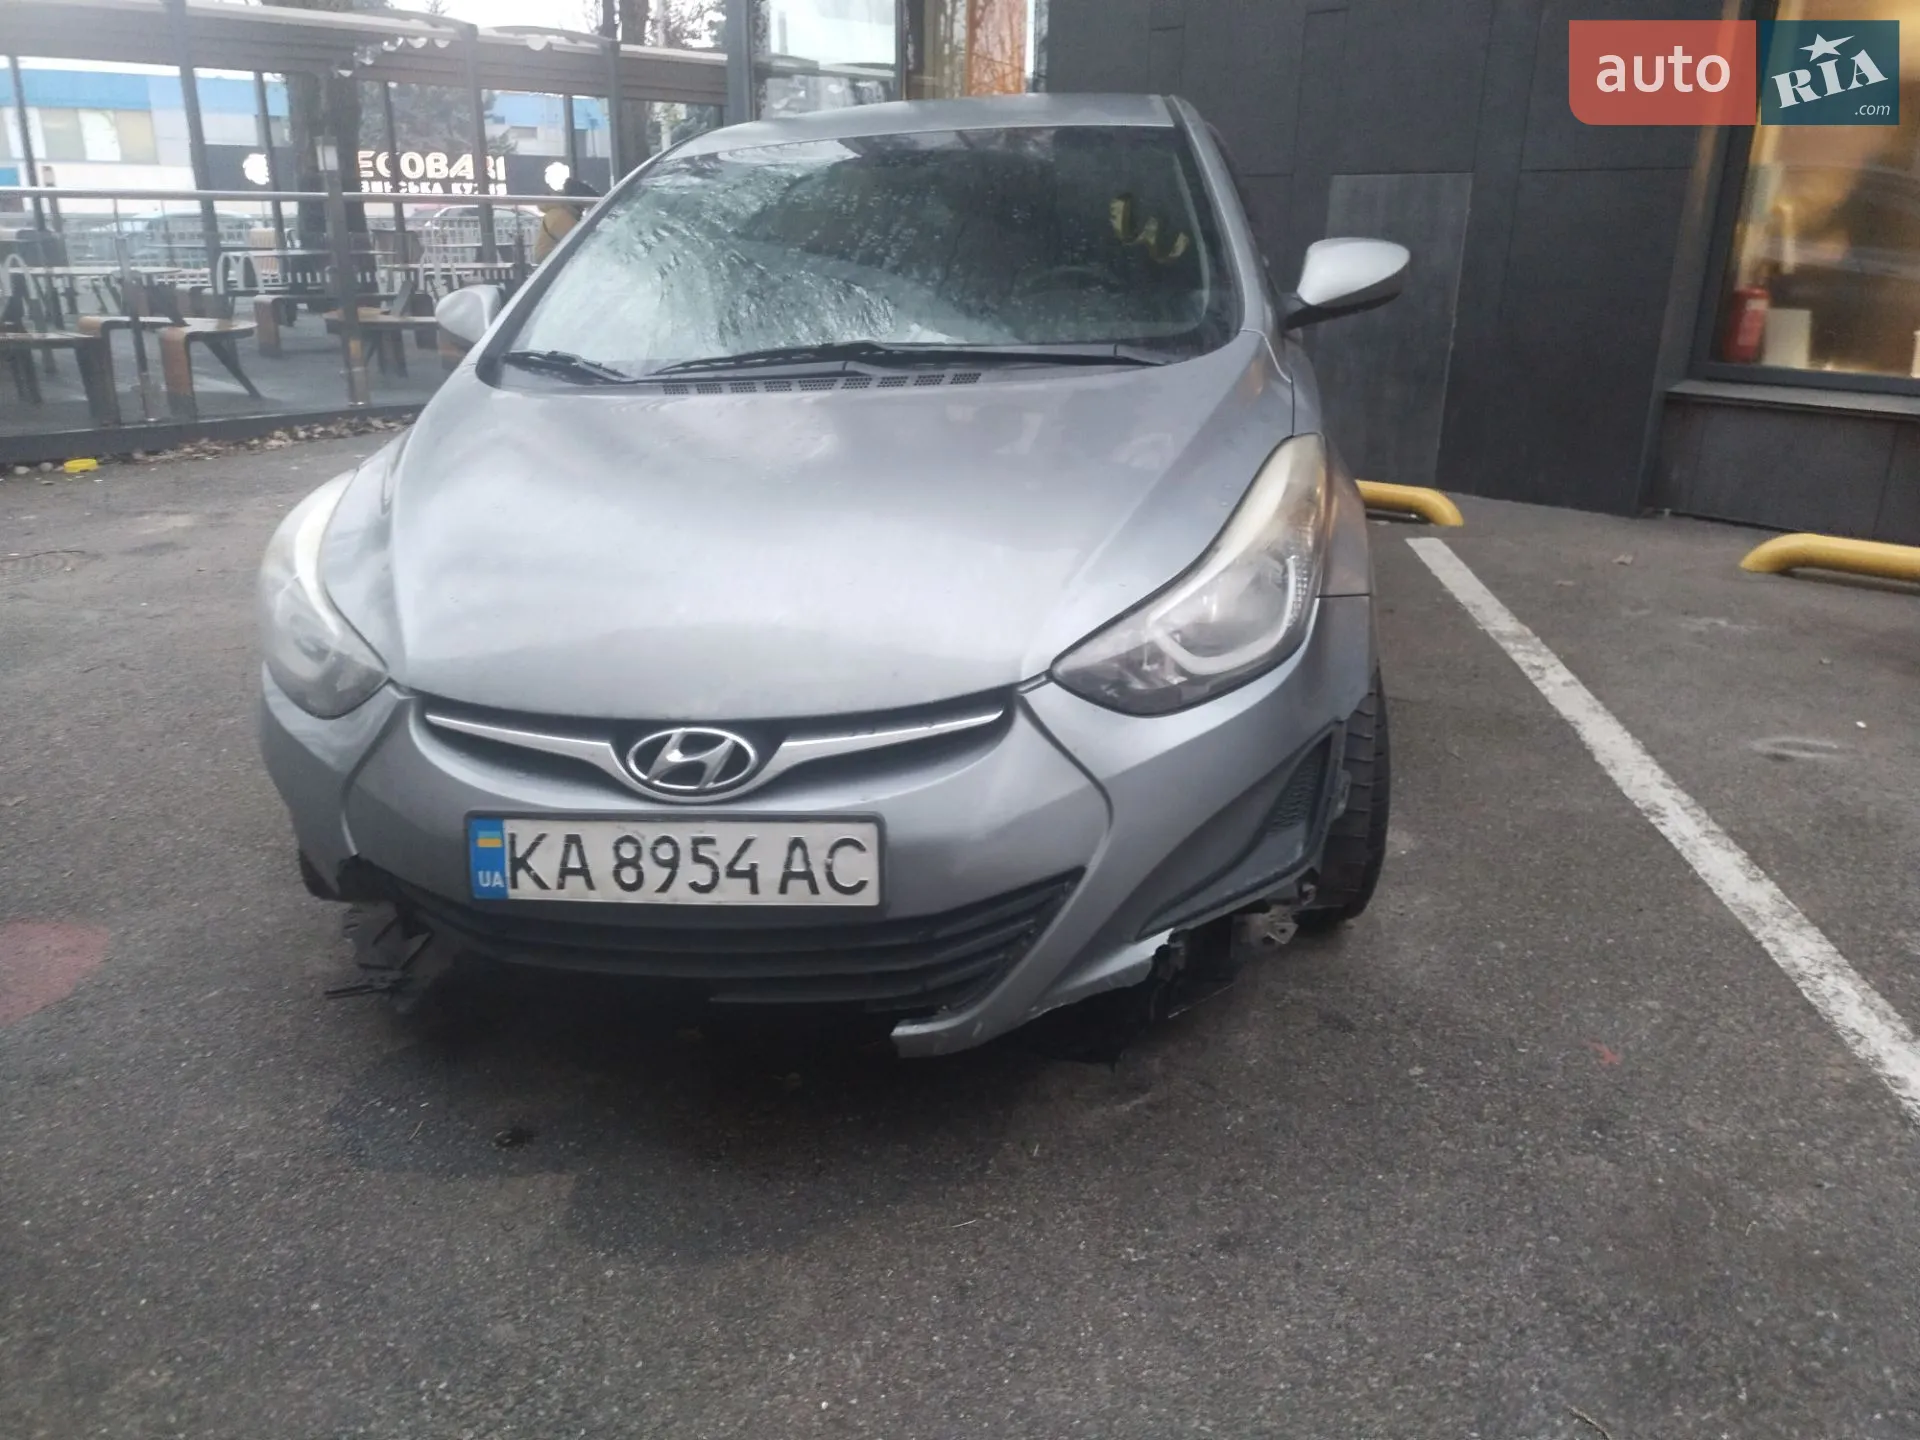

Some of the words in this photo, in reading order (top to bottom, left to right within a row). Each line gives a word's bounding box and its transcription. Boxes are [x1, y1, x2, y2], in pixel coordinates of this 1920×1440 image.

[478, 871, 504, 888] UA
[508, 832, 596, 892] KA
[612, 834, 760, 895] 8954
[777, 836, 869, 896] AC
